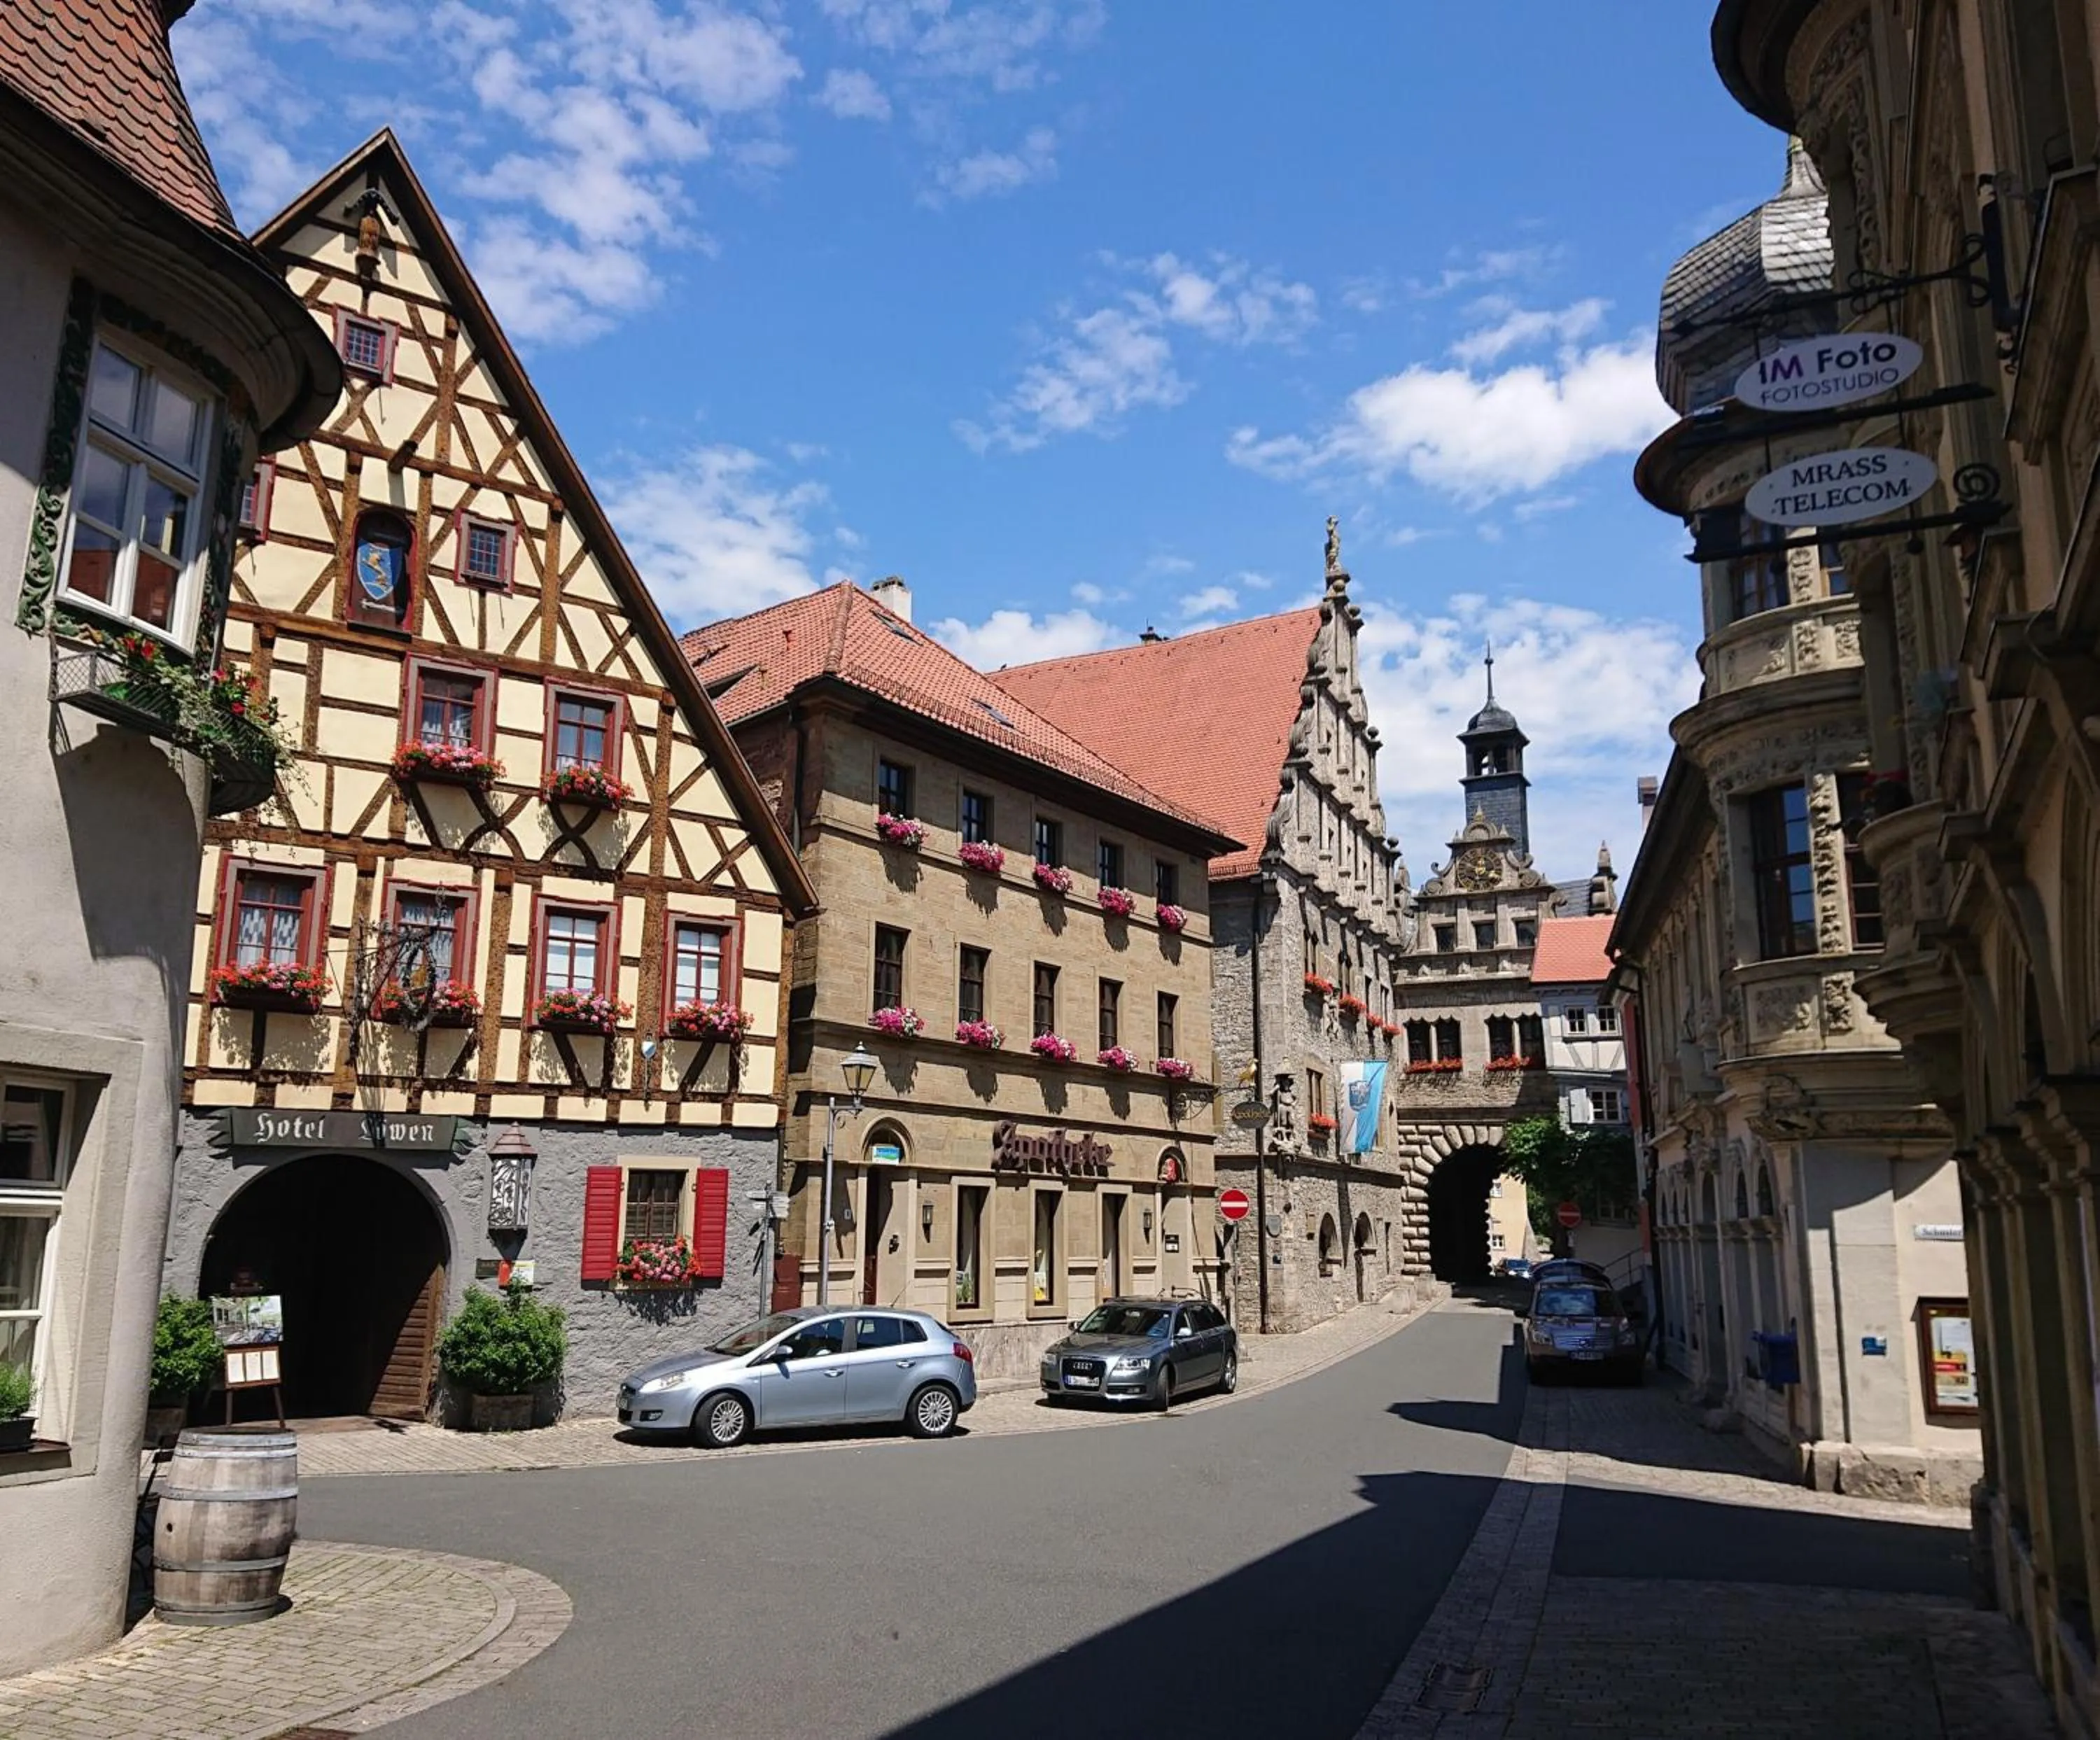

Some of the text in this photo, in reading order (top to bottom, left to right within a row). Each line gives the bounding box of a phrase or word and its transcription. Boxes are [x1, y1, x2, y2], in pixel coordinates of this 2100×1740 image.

[1758, 341, 1897, 384] IM Foto
[1760, 367, 1899, 405] FOTOSTUDIO
[1791, 454, 1888, 488] MRASS
[1773, 477, 1911, 516] TELECOM
[253, 1112, 326, 1143] Hotel
[993, 1120, 1116, 1170] Apotheke
